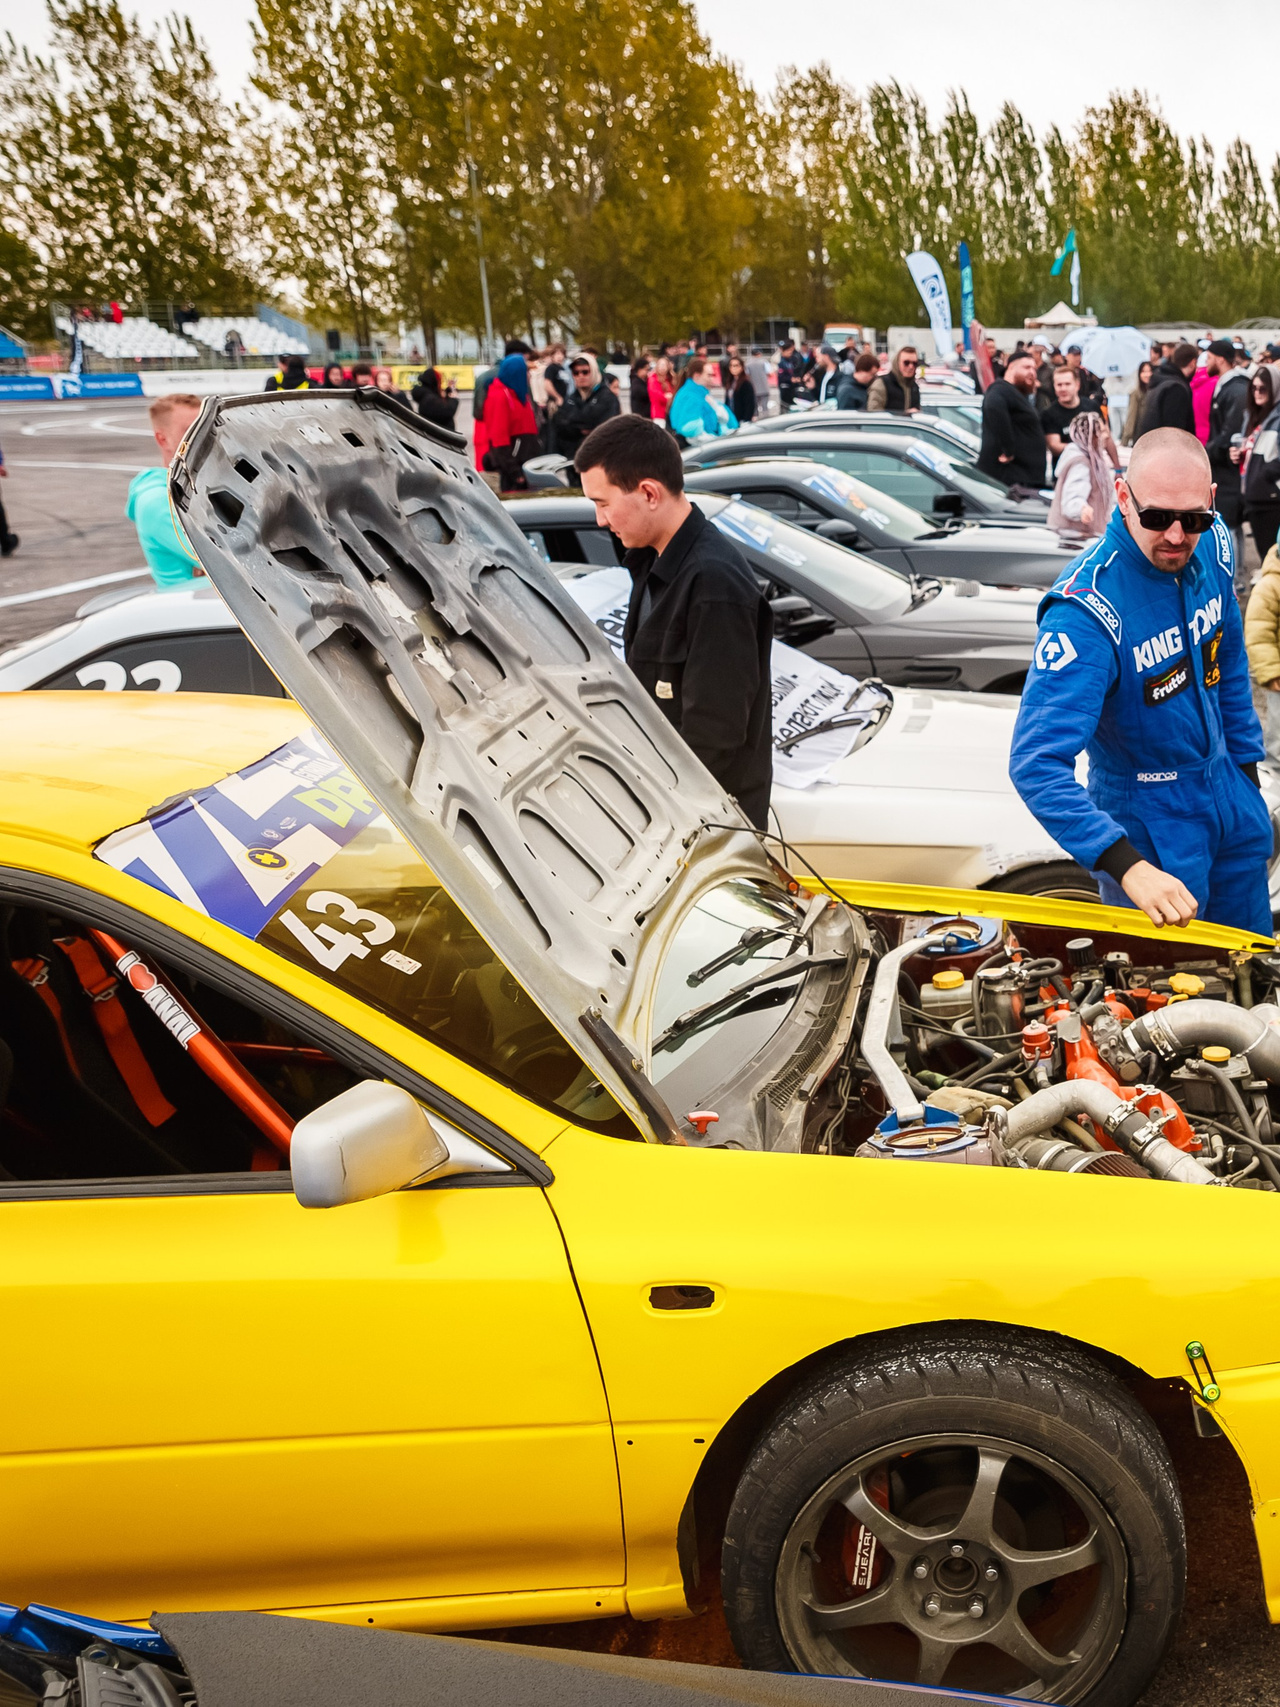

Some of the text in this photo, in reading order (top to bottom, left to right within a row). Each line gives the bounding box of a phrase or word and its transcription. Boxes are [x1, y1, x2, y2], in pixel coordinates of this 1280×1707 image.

[1084, 593, 1119, 631] sparco
[1133, 593, 1222, 673] KING TONY
[1152, 669, 1187, 700] frütta
[1136, 771, 1178, 783] sparco
[278, 890, 396, 972] 43
[143, 984, 201, 1050] ANAL
